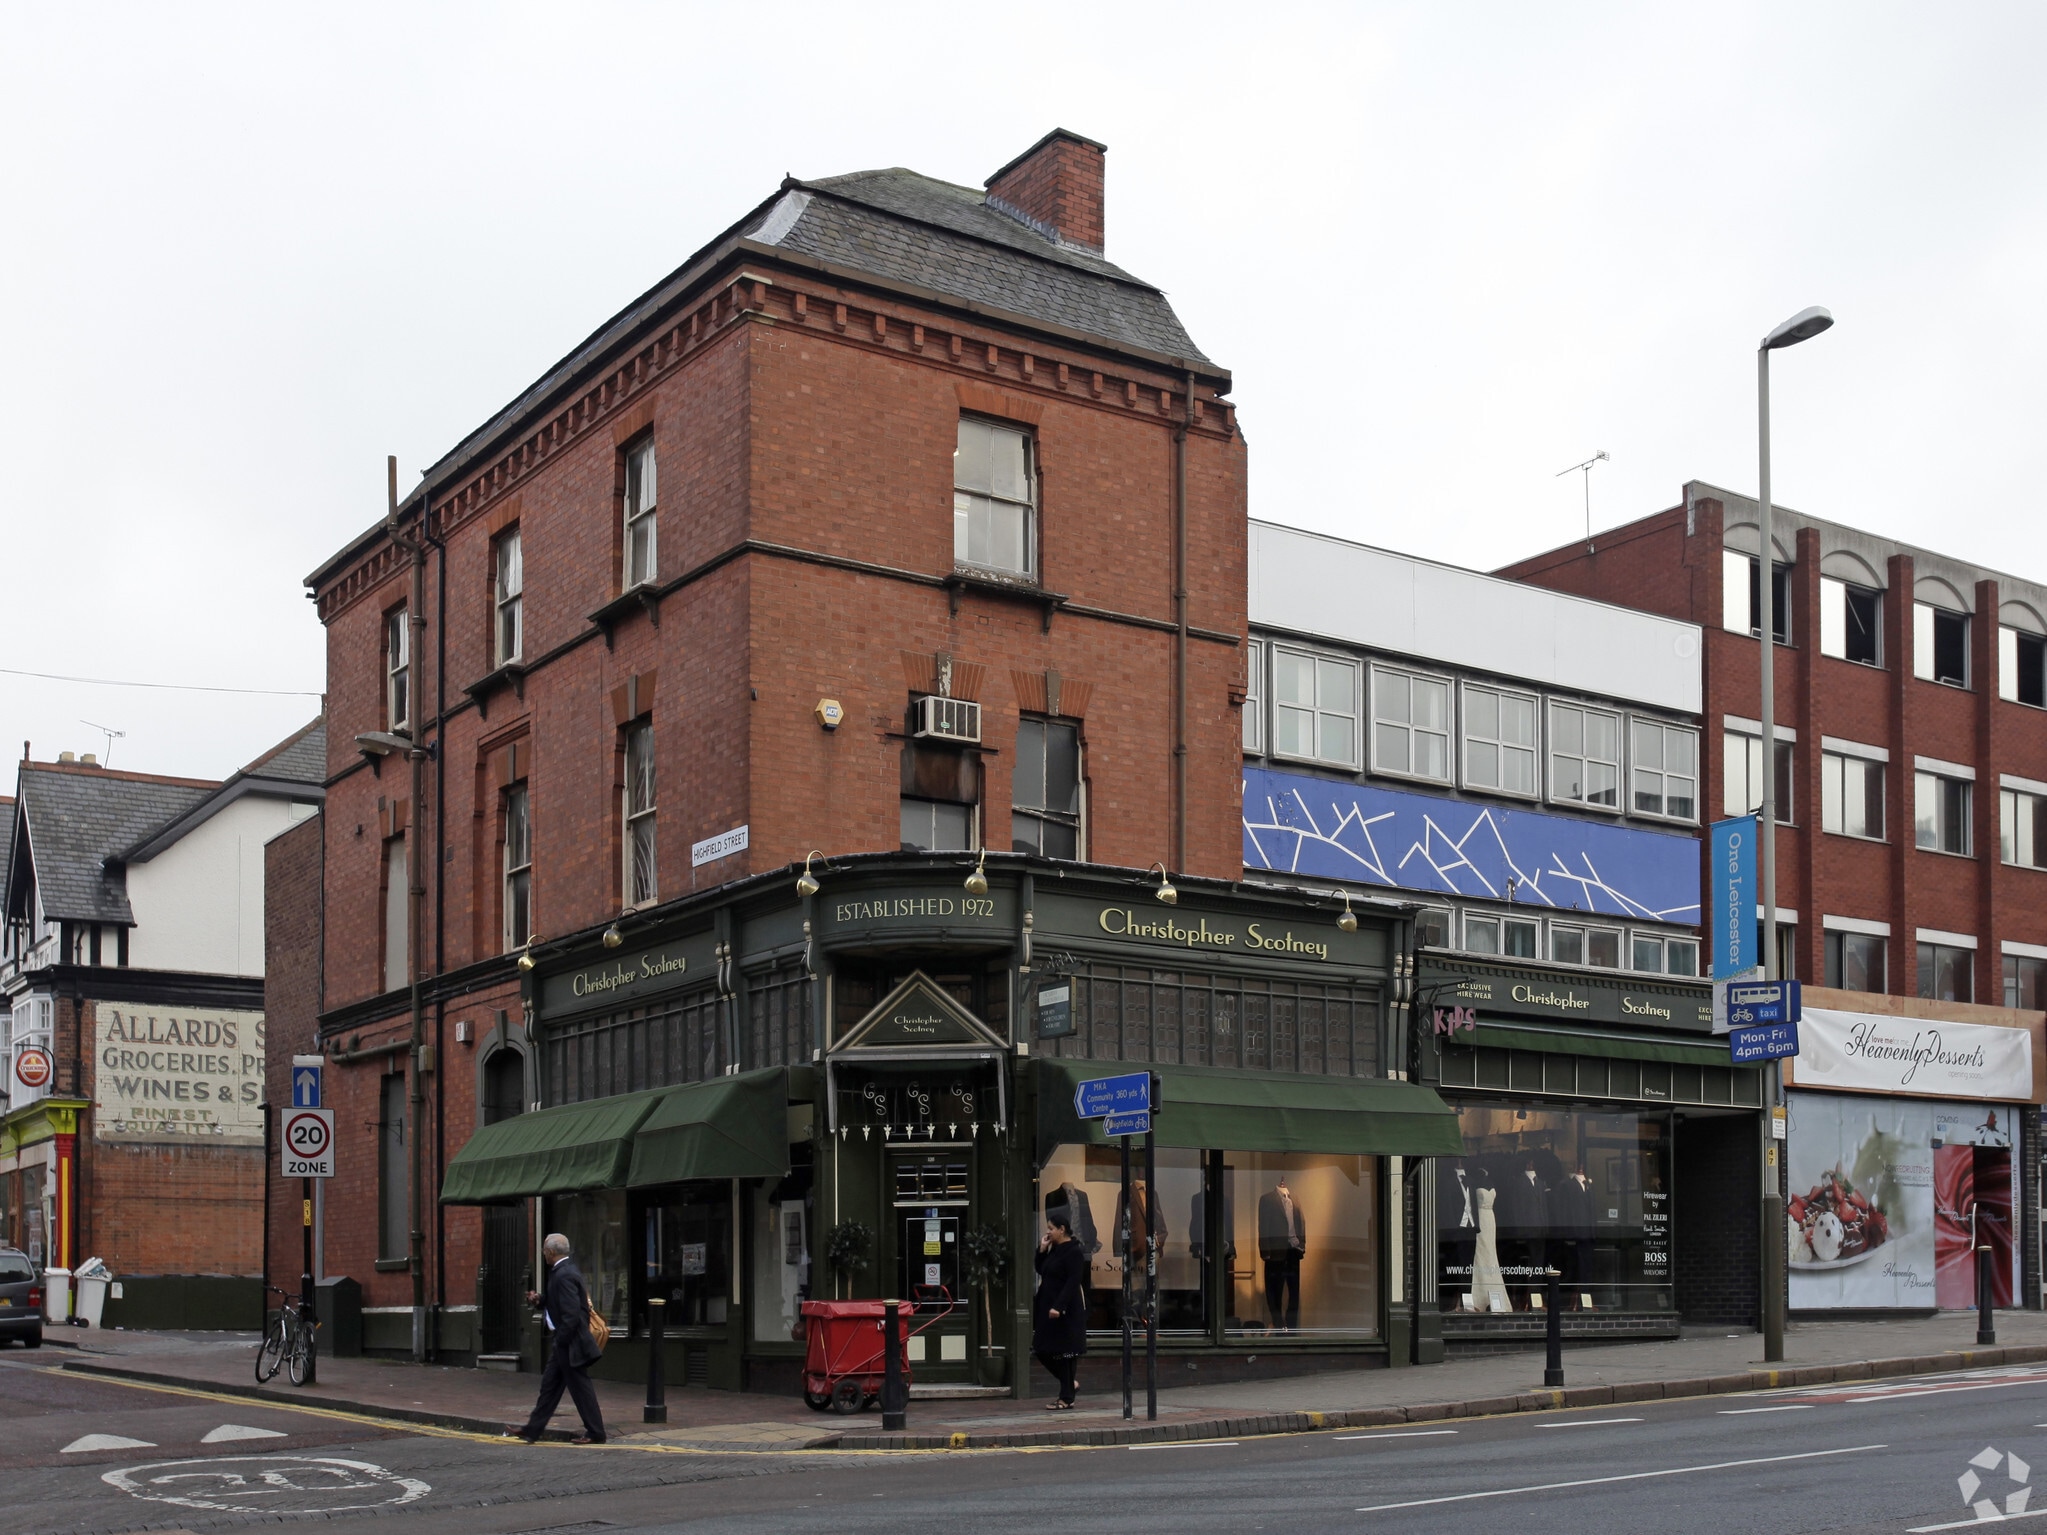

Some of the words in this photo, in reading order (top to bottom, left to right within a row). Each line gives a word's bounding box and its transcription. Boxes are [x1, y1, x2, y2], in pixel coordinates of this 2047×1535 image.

[694, 841, 721, 860] HIGHFIELD
[723, 832, 746, 850] STREET
[1729, 833, 1742, 874] One
[837, 898, 954, 922] ESTABLISHED
[961, 899, 994, 917] 1972
[1729, 877, 1742, 965] Leicester
[1099, 908, 1235, 946] Christopher
[1244, 923, 1327, 960] Scotney
[573, 963, 636, 997] Christopher
[640, 954, 686, 979] Scotney
[1457, 991, 1472, 999] HIRE
[1473, 992, 1492, 1000] WEAR
[1511, 985, 1590, 1010] Christopher
[1621, 996, 1670, 1021] Scotney
[894, 1016, 943, 1025] Christopher
[1434, 1005, 1475, 1036] KIDS
[1759, 1008, 1778, 1018] taxi
[105, 1010, 238, 1048] ALLARD'S
[902, 1024, 935, 1033] Scotney
[1740, 1029, 1788, 1044] Mon-Fri
[1736, 1042, 1794, 1058] 4pm-6pm
[1844, 1022, 1924, 1085] Heavenly
[1922, 1030, 1984, 1068] Desserts
[1948, 1071, 1969, 1080] opening
[113, 1075, 210, 1101] WINES
[218, 1085, 234, 1103] &
[1093, 1082, 1107, 1091] MKA
[1086, 1093, 1113, 1103] Community
[1128, 1089, 1137, 1099] yds
[130, 1107, 212, 1122] FINEST
[1092, 1105, 1108, 1113] Centre
[1110, 1120, 1134, 1130] ighfields
[294, 1126, 322, 1145] 20
[288, 1161, 328, 1173] ZONE
[1643, 1192, 1668, 1200] Hirewear
[1644, 1252, 1667, 1262] BOSS
[1882, 1262, 1917, 1287] Heavenly
